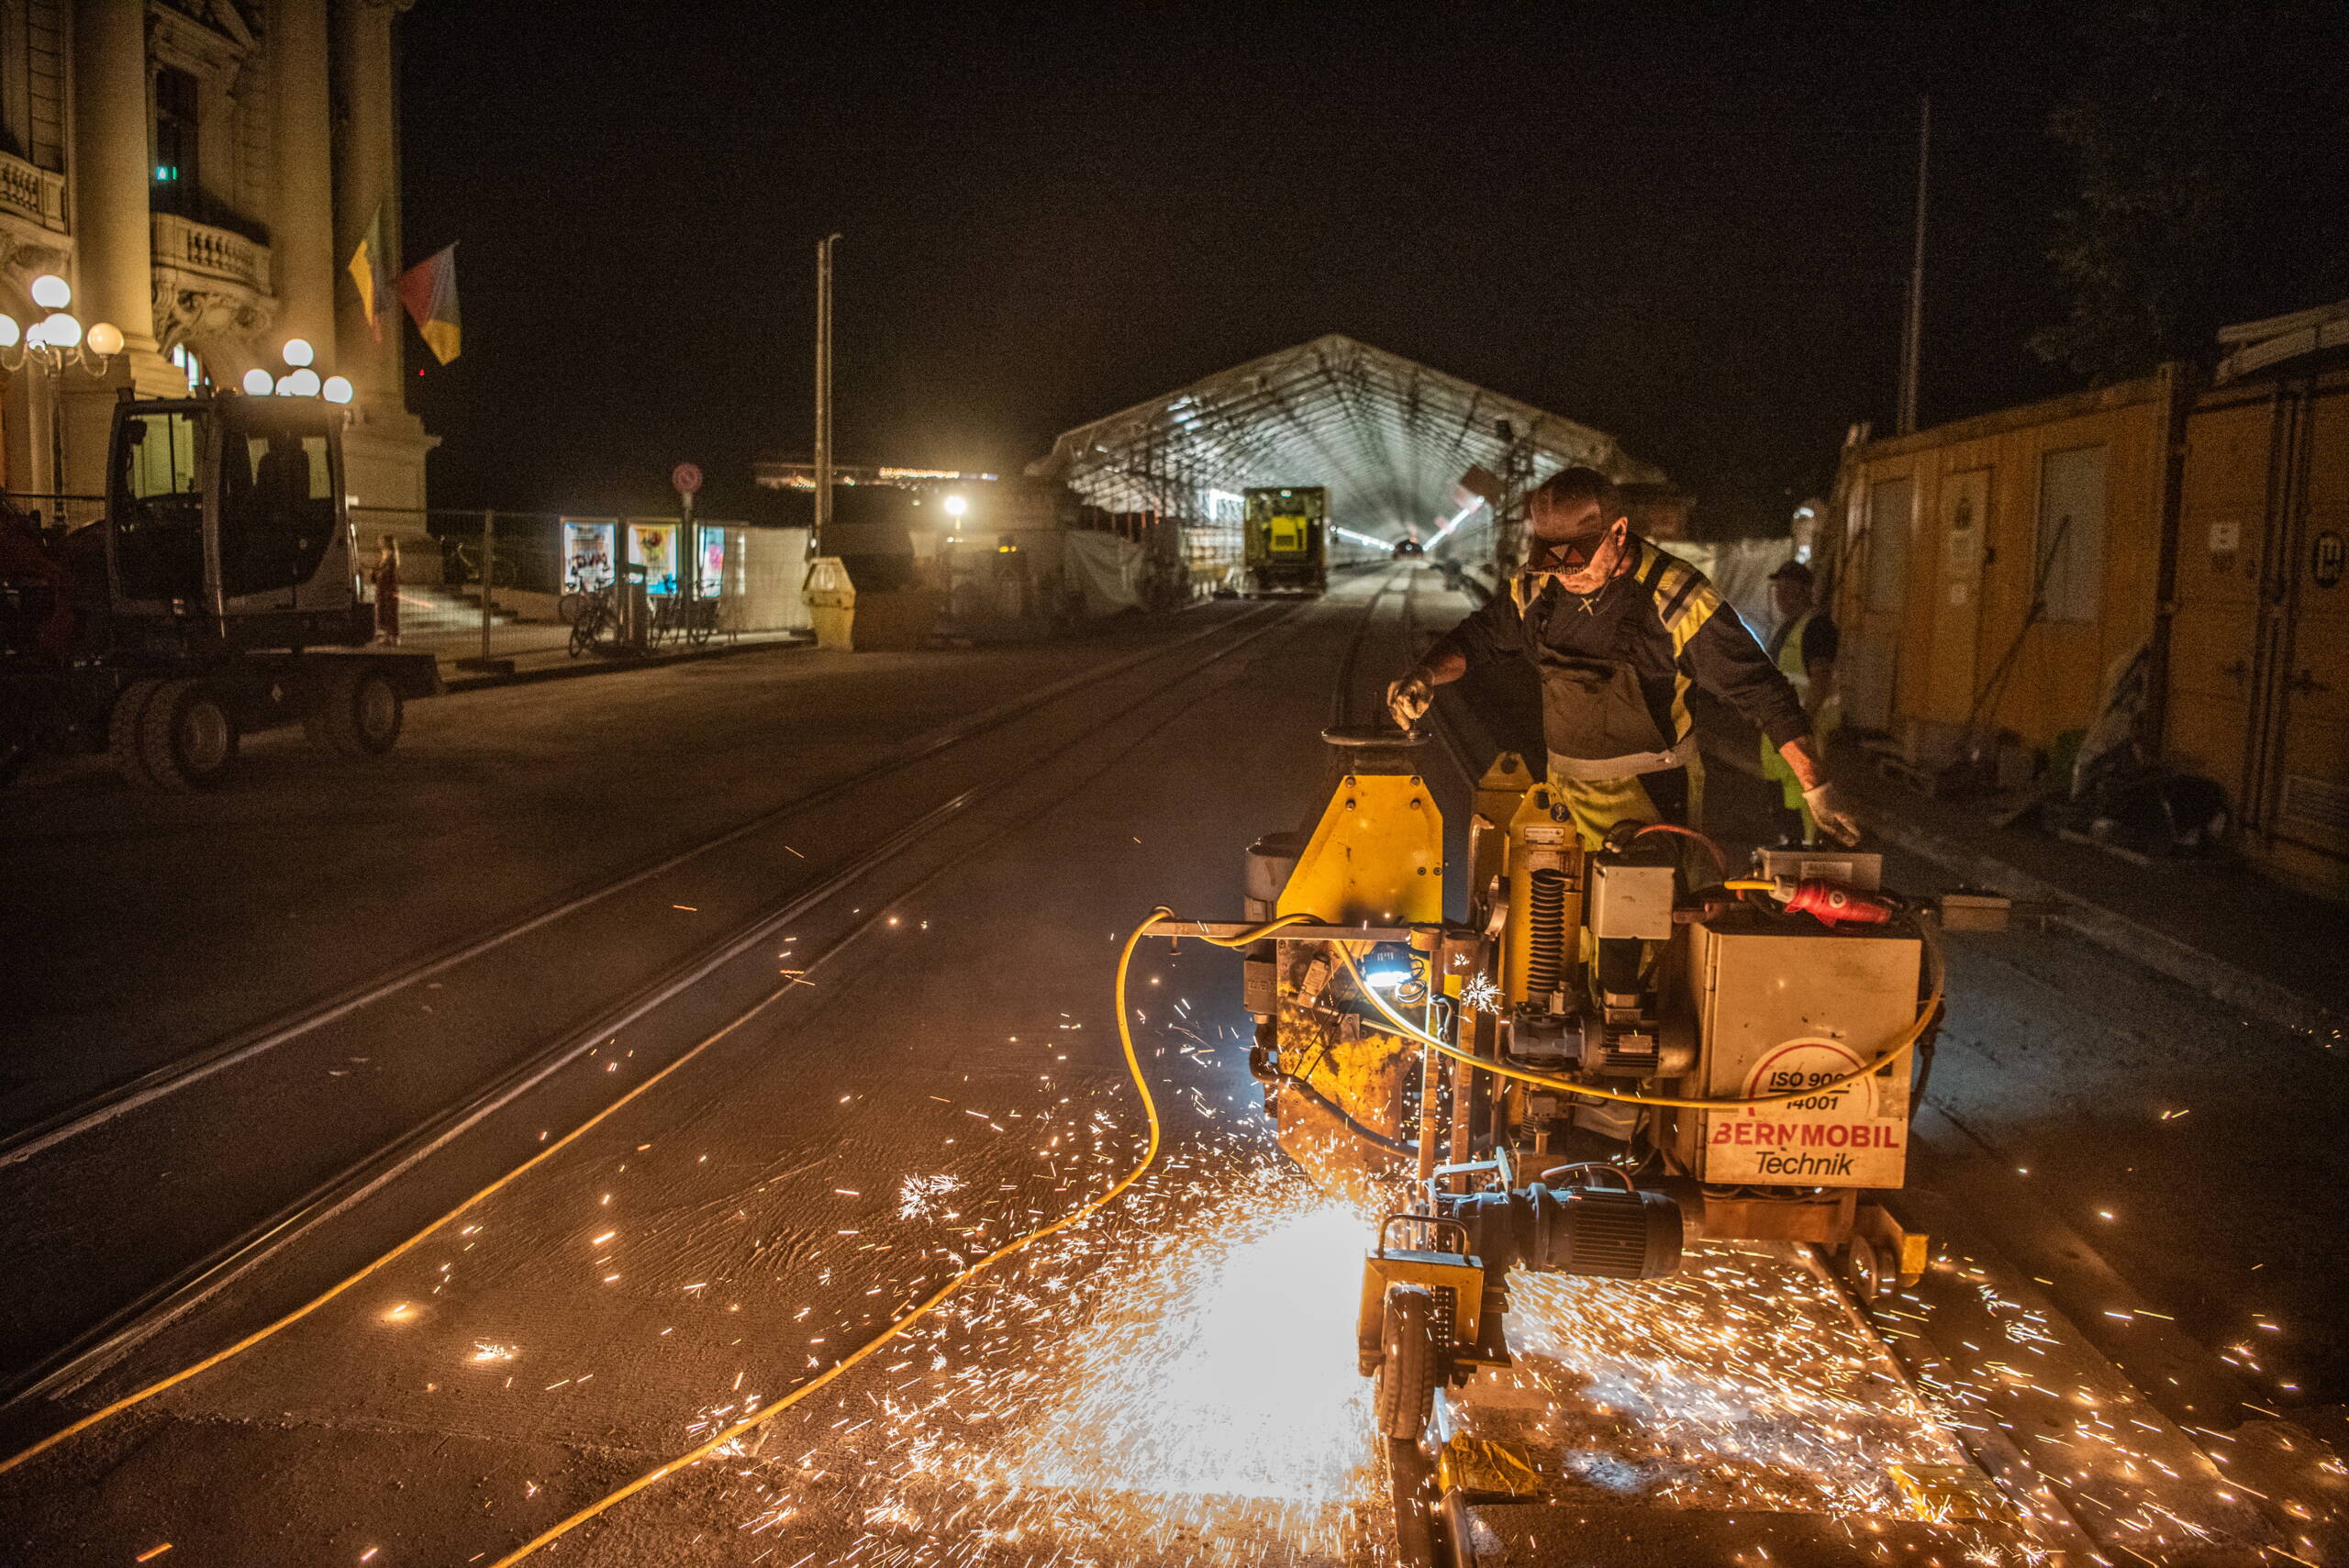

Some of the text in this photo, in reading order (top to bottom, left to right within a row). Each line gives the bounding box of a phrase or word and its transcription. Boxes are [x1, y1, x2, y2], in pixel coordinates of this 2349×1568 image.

[1770, 1072, 1852, 1088] ISO 90
[1711, 1122, 1900, 1149] BERNMOBIL
[1755, 1151, 1854, 1176] Technik
